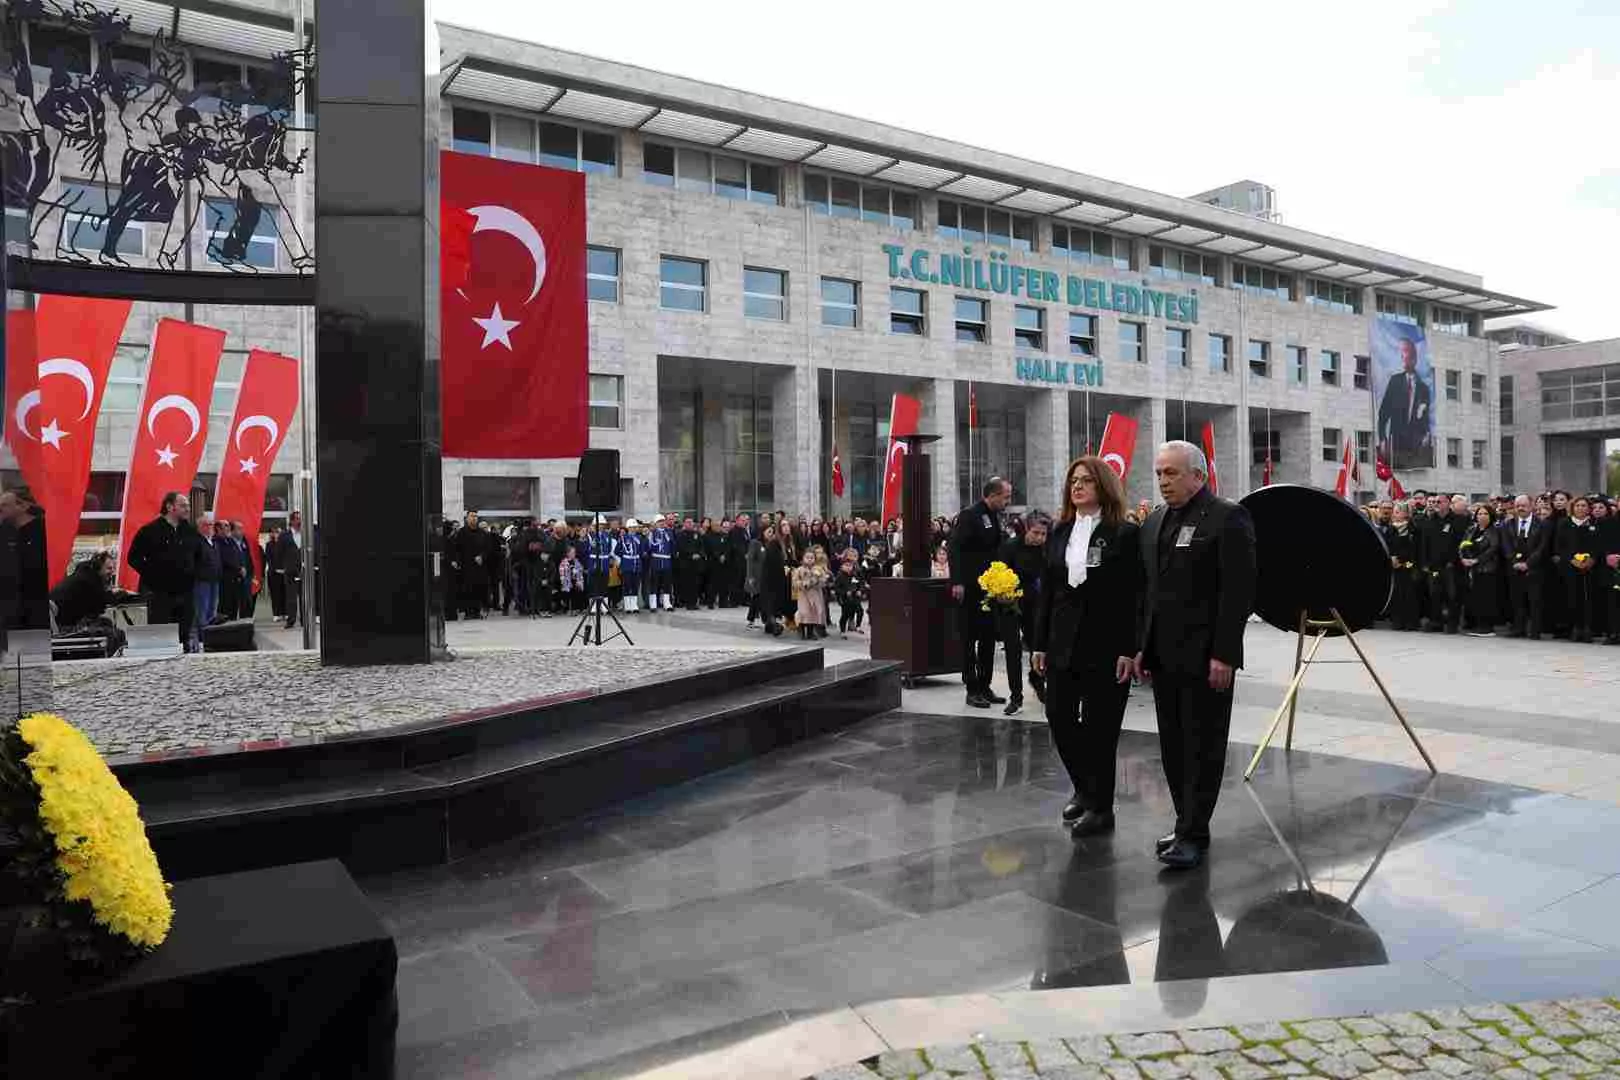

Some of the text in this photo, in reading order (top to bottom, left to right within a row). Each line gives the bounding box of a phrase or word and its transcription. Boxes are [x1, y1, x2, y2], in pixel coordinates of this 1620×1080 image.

[1067, 275, 1199, 324] BELEDİYESİ
[1016, 357, 1104, 387] HALK EVİ
